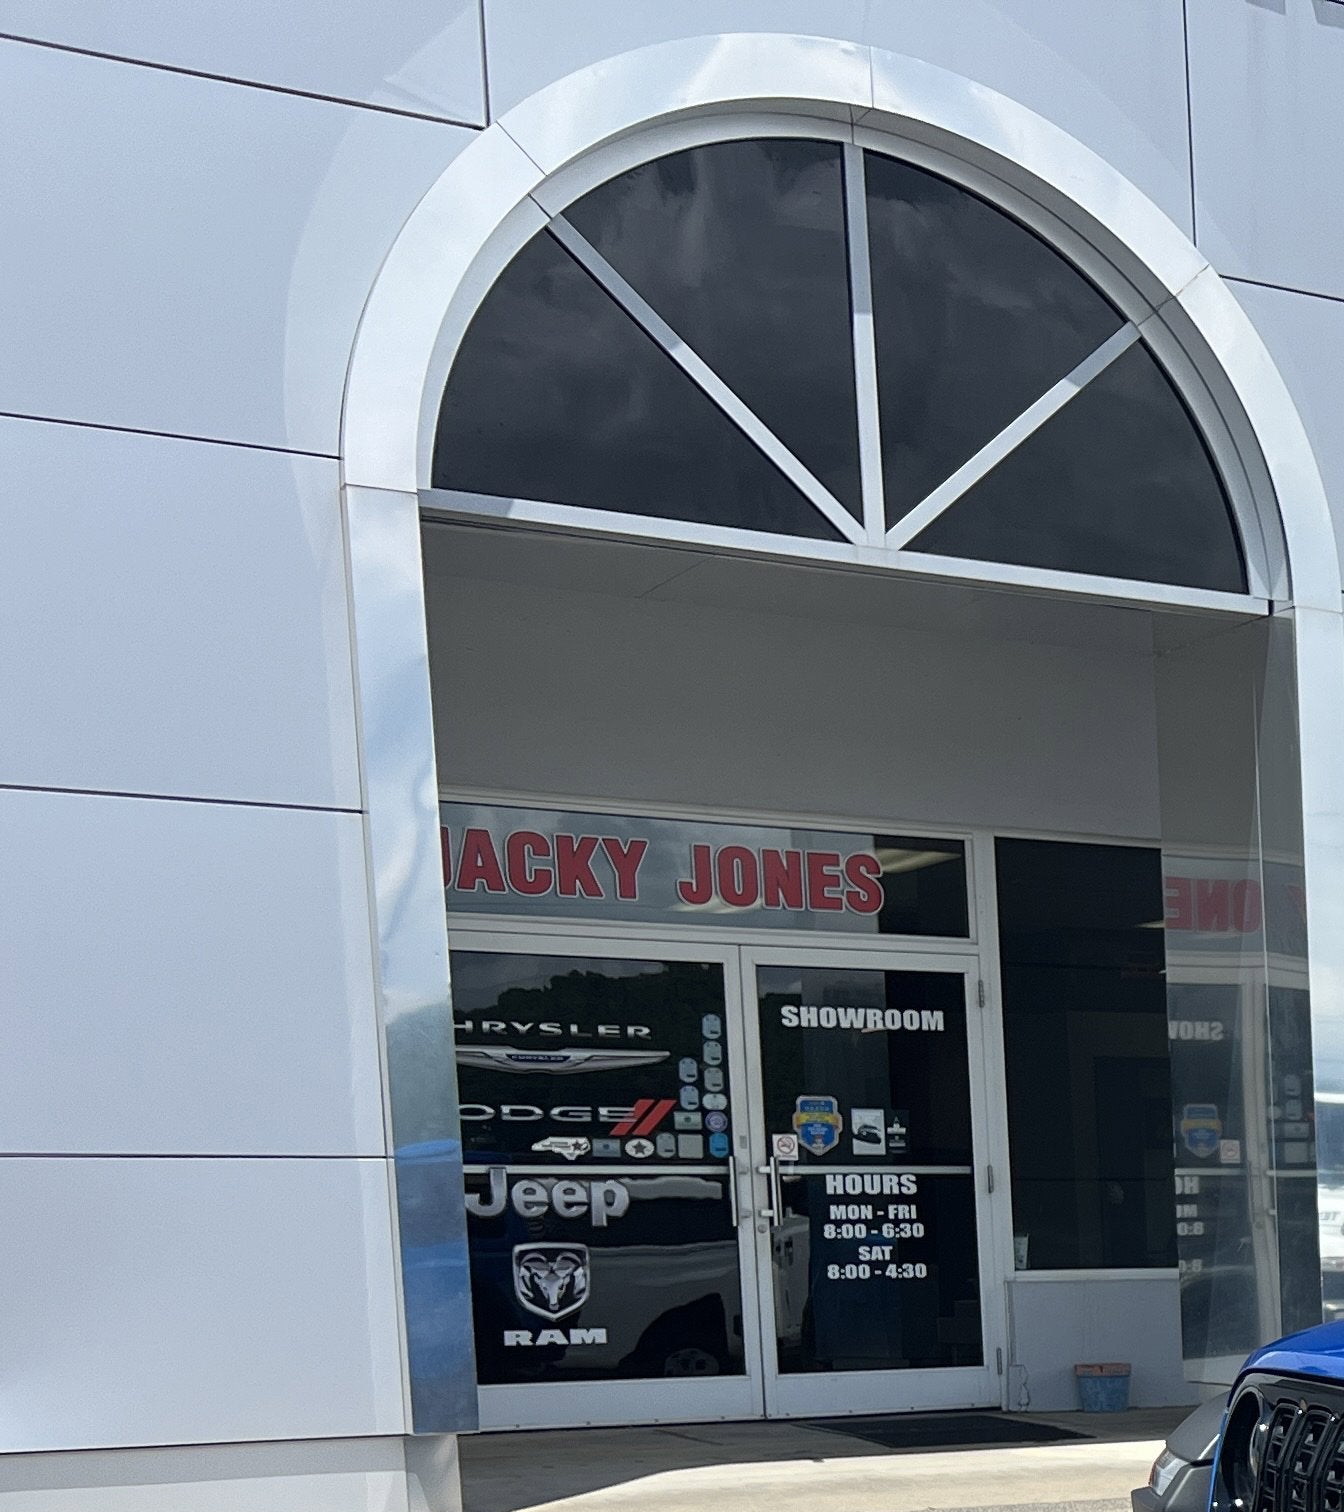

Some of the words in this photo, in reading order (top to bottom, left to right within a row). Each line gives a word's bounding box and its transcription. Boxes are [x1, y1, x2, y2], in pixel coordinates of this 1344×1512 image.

[441, 825, 649, 900] ACKY
[677, 843, 884, 916] JONES
[780, 1004, 945, 1032] SHOWROOM
[453, 1020, 652, 1039] HRYSLER
[459, 1104, 637, 1123] ODGE
[825, 1174, 918, 1195] HOURS
[464, 1166, 630, 1227] Jeep
[829, 1204, 873, 1220] MON
[888, 1204, 917, 1220] FRI
[823, 1223, 867, 1239] 8:00
[882, 1222, 925, 1238] 6:30
[858, 1245, 893, 1261] SAT
[827, 1263, 871, 1280] 8:00
[885, 1262, 928, 1279] 4:30
[503, 1327, 608, 1346] RAM
